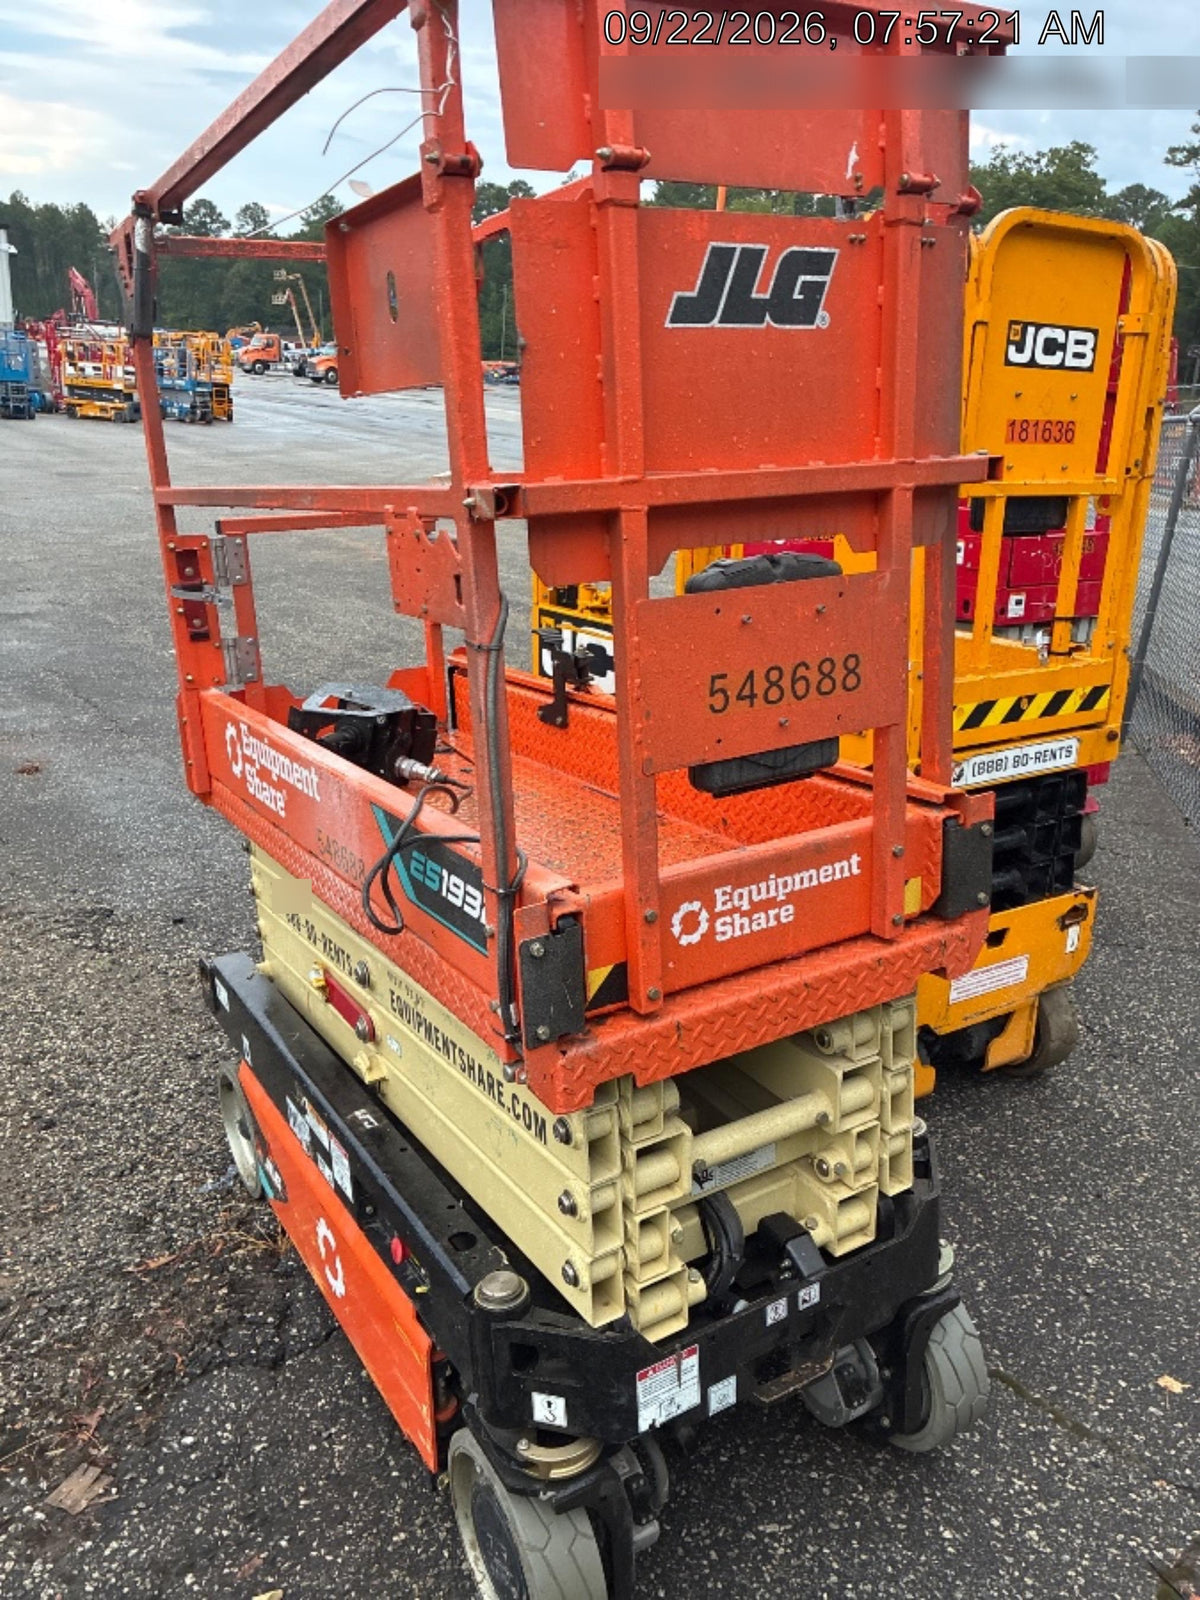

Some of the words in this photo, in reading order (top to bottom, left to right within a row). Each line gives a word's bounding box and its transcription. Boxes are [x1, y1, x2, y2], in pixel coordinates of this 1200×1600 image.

[1007, 325, 1095, 369] JCB
[1008, 419, 1076, 443] 181636
[709, 653, 862, 714] 548688
[239, 721, 320, 803] Equipment
[1012, 744, 1073, 769] 80-RENTS
[244, 762, 286, 818] Share
[409, 850, 487, 926] ES193
[714, 852, 861, 913] Equipment
[714, 902, 795, 942] Share
[389, 988, 548, 1146] EQUIPMENTSHARE.COM
